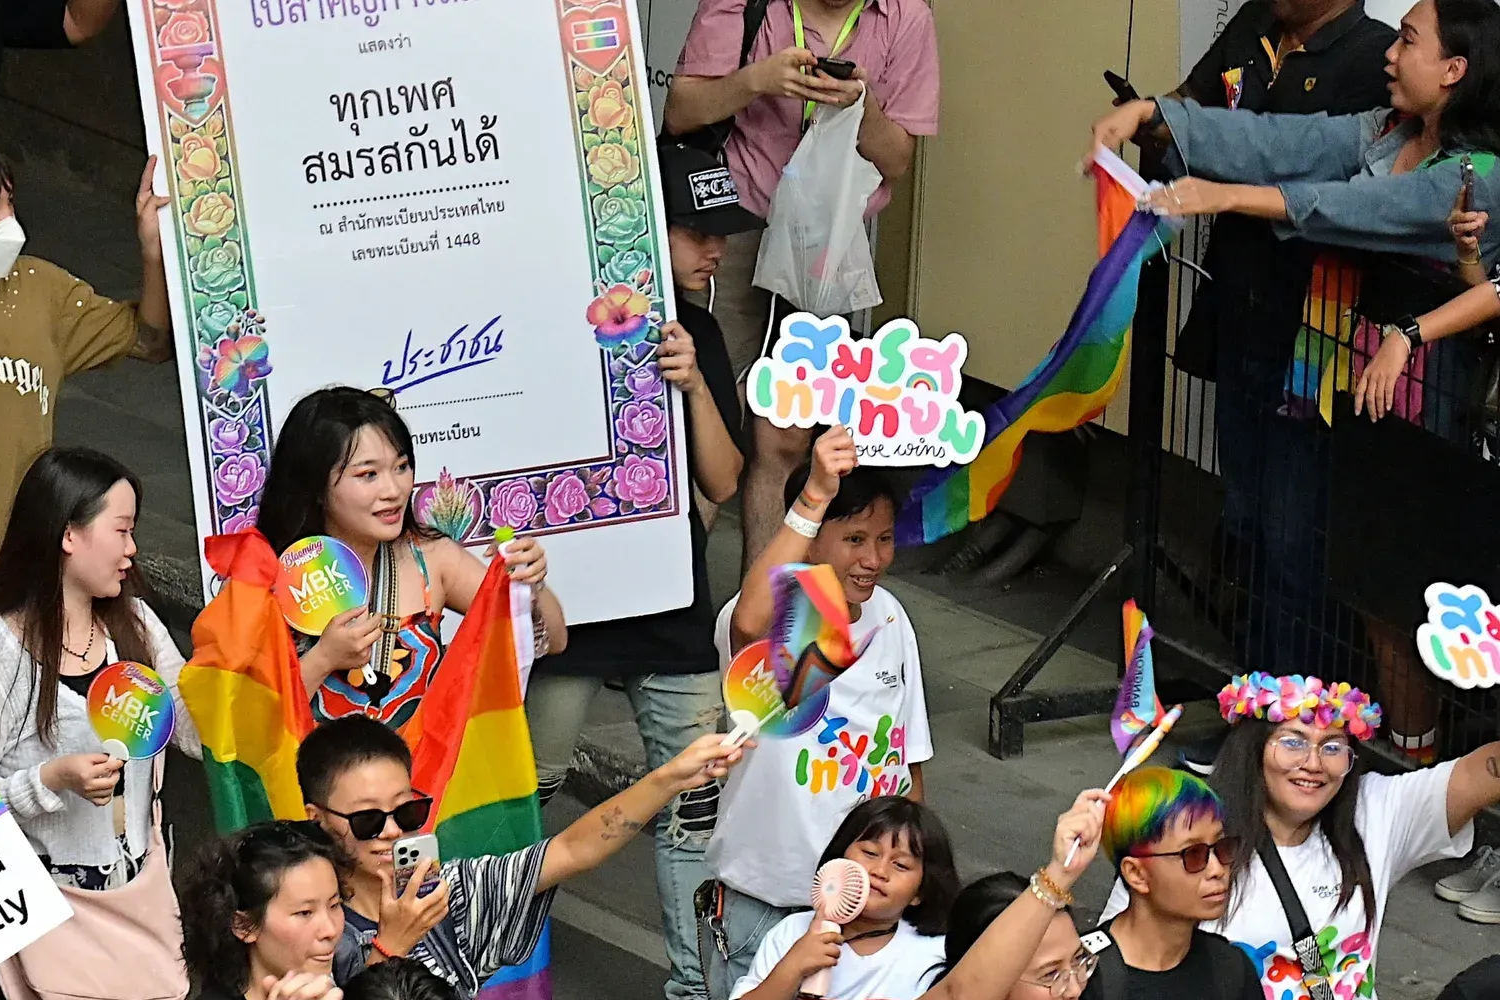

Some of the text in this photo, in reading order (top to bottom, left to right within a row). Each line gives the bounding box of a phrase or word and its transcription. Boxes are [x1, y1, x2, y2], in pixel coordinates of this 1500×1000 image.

[358, 33, 412, 54] แสดงว่า
[329, 77, 456, 136] ทุกเพศ
[302, 114, 501, 184] สมรสกันได้
[319, 197, 505, 236] ณ สำนักทะเบียนประเทศไทย
[351, 231, 481, 261] เลขทะเบียนที่ 1448
[382, 314, 504, 385] ประชาชน
[756, 366, 977, 454] เท่าเทียม
[894, 438, 946, 458] wins
[288, 559, 347, 603] MBK
[300, 579, 353, 614] CENTER
[101, 705, 152, 742] CENTER
[104, 685, 160, 730] MBK
